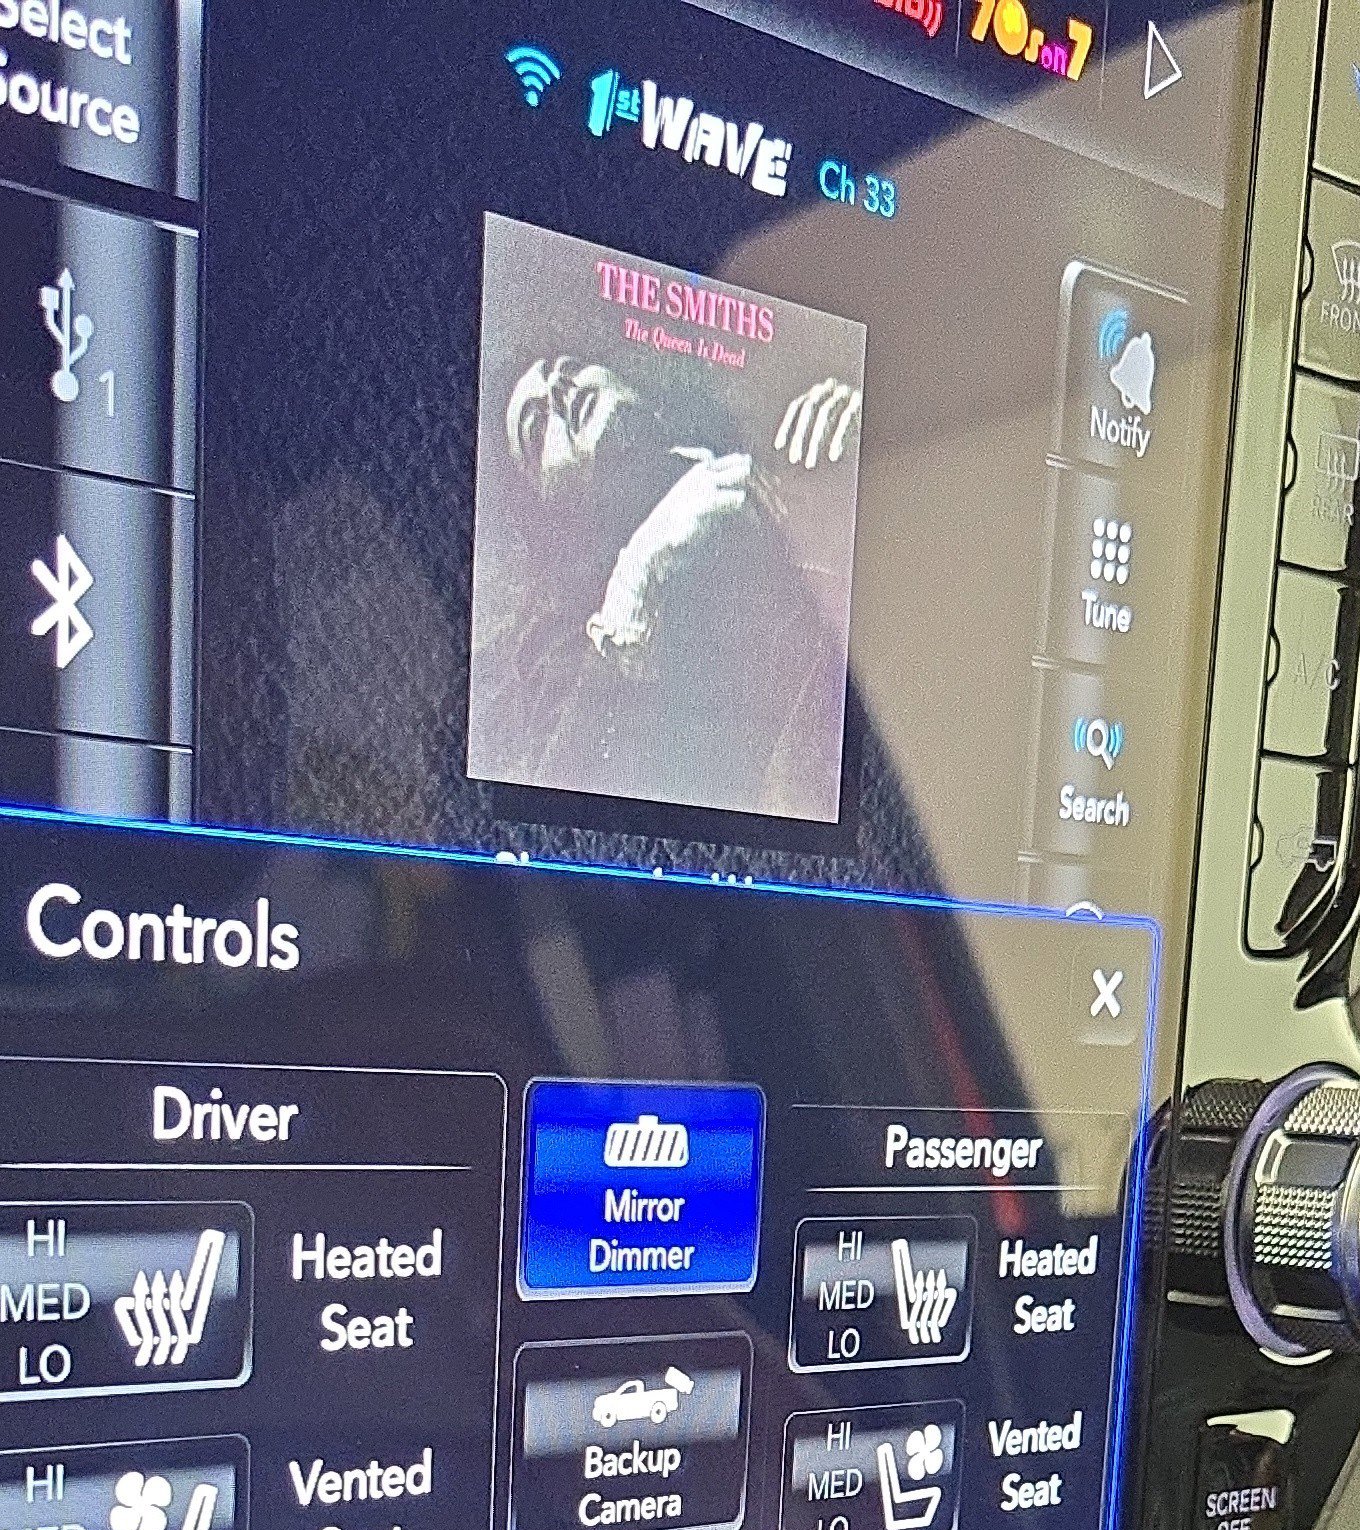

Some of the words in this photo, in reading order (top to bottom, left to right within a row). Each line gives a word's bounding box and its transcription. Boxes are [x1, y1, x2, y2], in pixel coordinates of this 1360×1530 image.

[818, 158, 855, 206] Ch
[863, 172, 897, 218] 33
[596, 261, 660, 314] THE
[664, 280, 776, 343] SMITHS
[624, 317, 649, 343] The
[652, 325, 692, 355] Queen
[708, 341, 746, 368] Dead
[98, 369, 115, 417] 1
[1089, 403, 1151, 459] Notify
[1081, 586, 1132, 634] Tune
[1058, 782, 1131, 828] Search
[25, 882, 301, 971] Controls
[151, 1084, 300, 1141] Driver
[884, 1123, 1043, 1177] Passenger
[604, 1188, 686, 1224] Mirror
[26, 1218, 67, 1257] HI
[291, 1228, 443, 1281] Heated
[588, 1237, 696, 1275] Dimmer
[837, 1230, 864, 1264] HI
[998, 1235, 1100, 1280] Heated
[818, 1279, 875, 1313] MED
[1012, 1295, 1078, 1336] Seat
[320, 1305, 415, 1351] Seat
[826, 1327, 862, 1362] LO
[17, 1343, 73, 1386] LO
[825, 1422, 853, 1454] HI
[987, 1411, 1084, 1458] Vented
[288, 1447, 434, 1507] Vented
[583, 1440, 682, 1480] Backup
[25, 1463, 66, 1504] HI
[807, 1467, 864, 1504] MED
[1000, 1471, 1063, 1514] Seat
[1206, 1485, 1277, 1519] SCREEN
[577, 1490, 684, 1528] Camera
